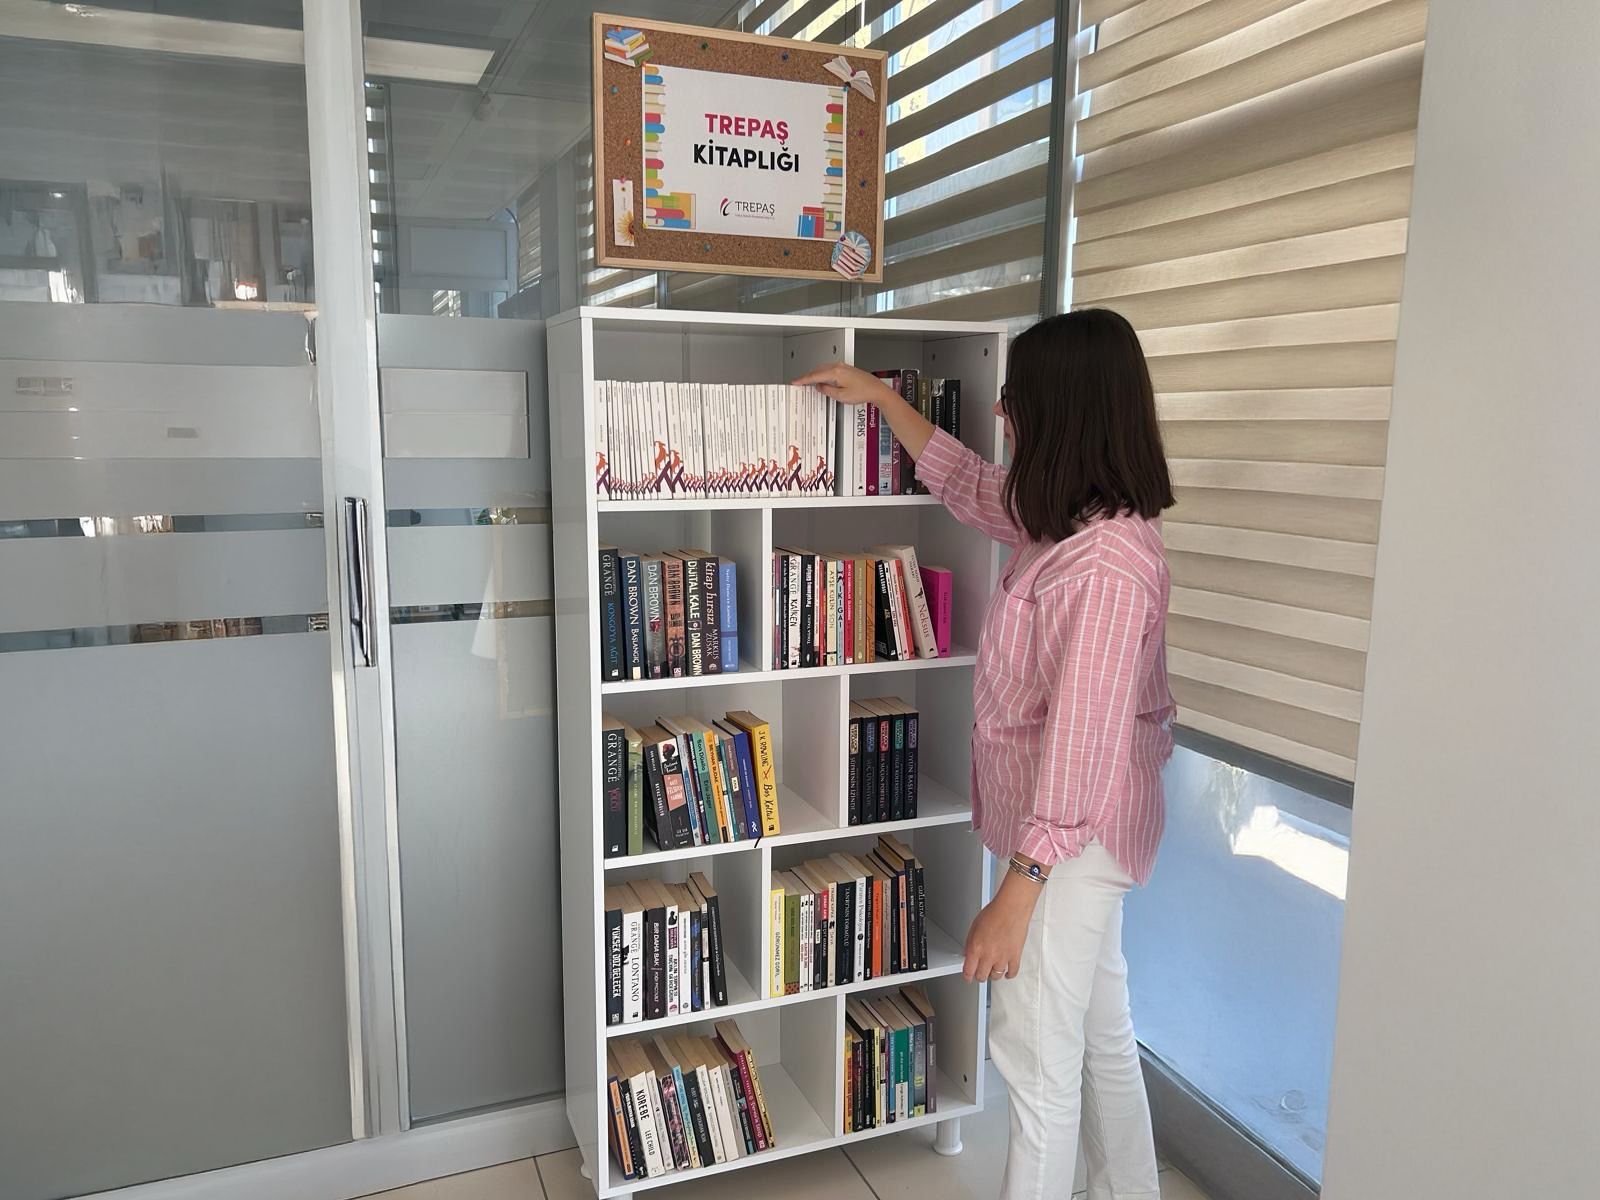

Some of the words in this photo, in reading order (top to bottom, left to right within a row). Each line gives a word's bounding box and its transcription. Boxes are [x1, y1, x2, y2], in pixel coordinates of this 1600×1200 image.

[704, 113, 789, 145] TREPAŞ
[693, 139, 799, 172] KİTAPLIĞI
[734, 201, 775, 216] TREPAŞ
[857, 409, 865, 437] SAPIENS
[626, 560, 637, 583] DAN
[647, 564, 657, 585] DAN
[667, 562, 679, 579] DAN
[704, 562, 716, 590] kitap
[628, 586, 639, 625] BROWN
[649, 585, 660, 622] BROWN
[668, 580, 680, 606] BROWN
[689, 595, 700, 619] KALE
[706, 592, 717, 625] hırsızı
[917, 603, 929, 638] Neksus
[691, 632, 701, 648] DAN
[705, 633, 713, 657] ZUSAK
[711, 629, 719, 660] MARKUS
[692, 648, 702, 676] BROWN
[607, 733, 619, 783] GRANGÉ
[764, 799, 775, 821] Koltuk
[612, 925, 621, 953] YÜKSEK
[612, 954, 621, 967] DOZ
[612, 967, 621, 998] GELECEK
[631, 957, 640, 1002] LONTANO
[644, 1130, 652, 1140] LEE
[647, 1140, 656, 1156] CHILD
